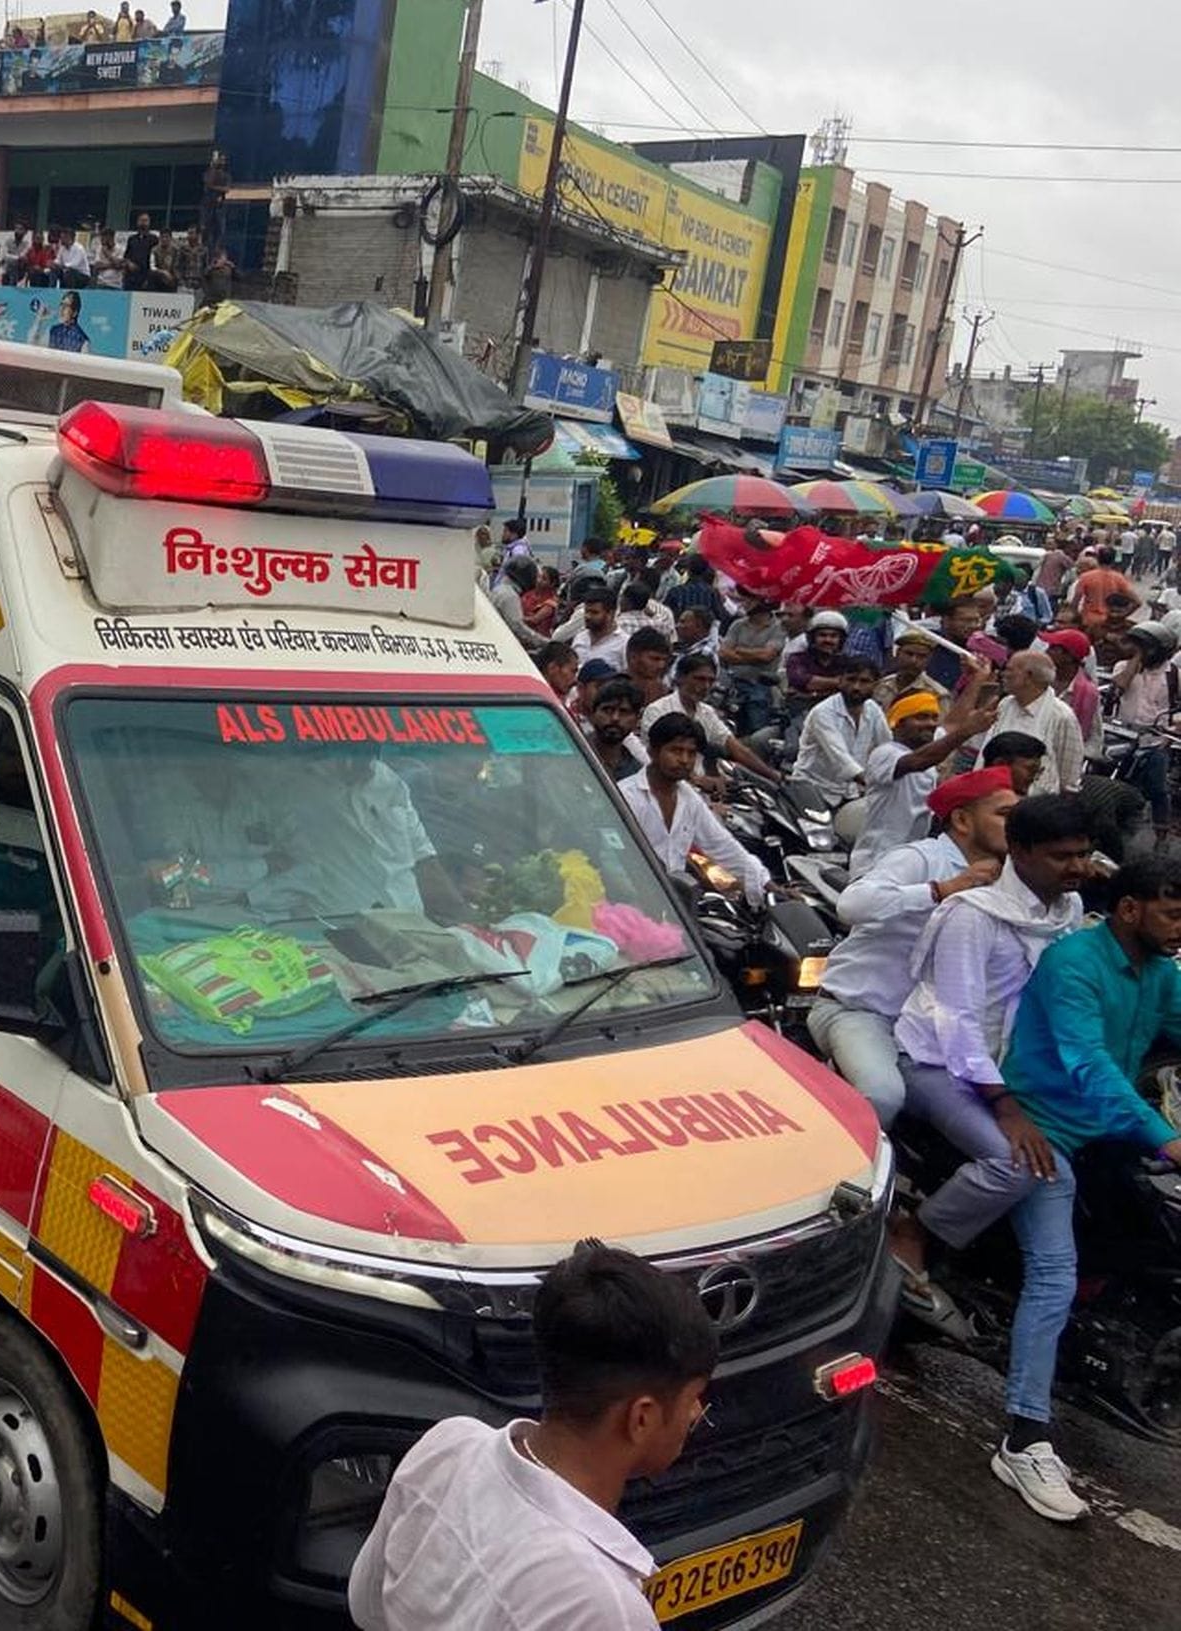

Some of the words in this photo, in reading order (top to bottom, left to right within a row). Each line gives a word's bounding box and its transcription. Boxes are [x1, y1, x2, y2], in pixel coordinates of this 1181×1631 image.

[86, 53, 102, 66] NEW
[97, 66, 122, 80] SWEET
[607, 183, 650, 217] CEMENT
[142, 307, 181, 319] TIWARI
[162, 527, 333, 596] निःशुल्क
[343, 544, 420, 590] सेवा
[94, 617, 174, 650] चिकित्सा
[174, 626, 238, 650] स्वास्थ्य
[265, 619, 320, 652] परिवार
[319, 630, 375, 655] कल्याण
[454, 639, 504, 664] सरकार
[216, 703, 286, 743] ALS
[292, 705, 487, 745] AMBULANCE
[1085, 1355, 1108, 1371] TVS
